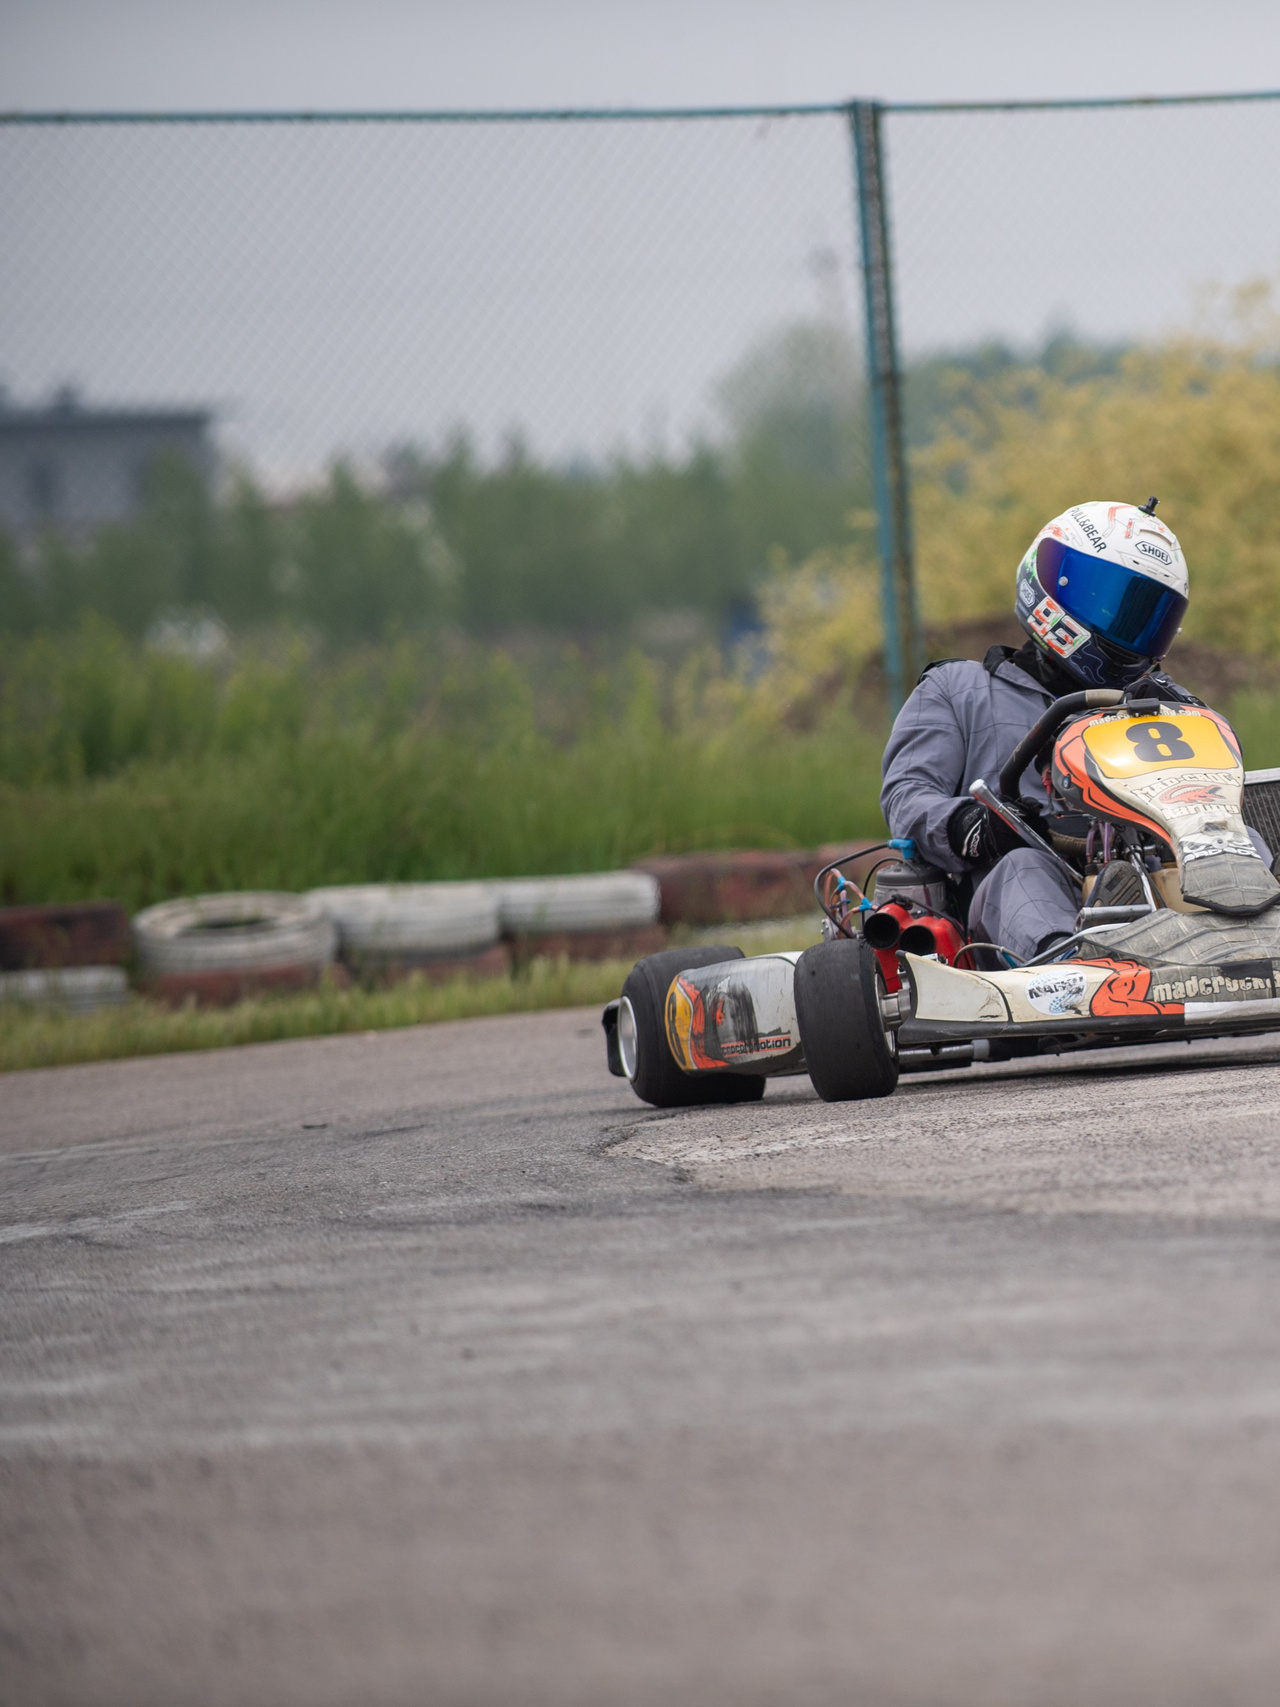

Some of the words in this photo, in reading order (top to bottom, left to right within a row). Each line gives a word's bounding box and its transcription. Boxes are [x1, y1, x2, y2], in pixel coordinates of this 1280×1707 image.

[1070, 507, 1107, 553] PULL&BEAR
[1141, 543, 1170, 563] SHOEI
[1027, 595, 1092, 659] 93
[1125, 721, 1195, 762] 8
